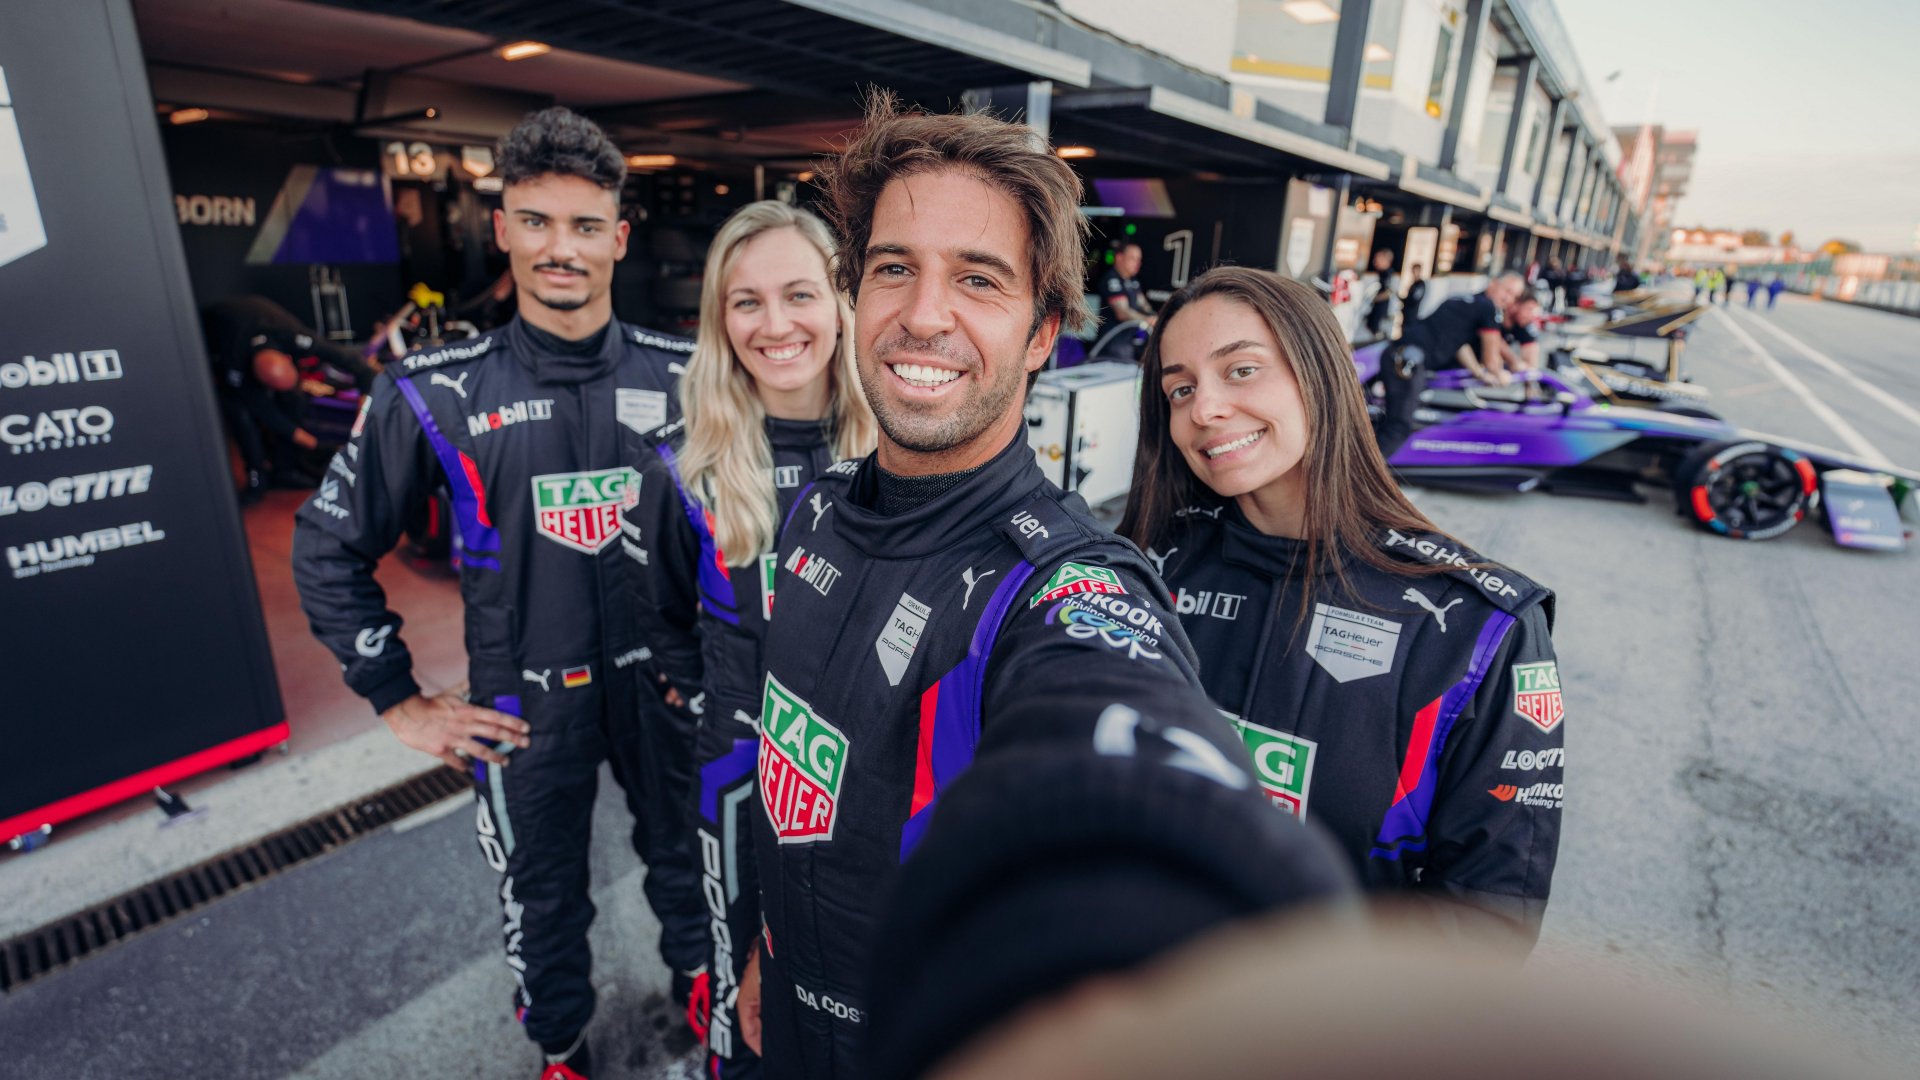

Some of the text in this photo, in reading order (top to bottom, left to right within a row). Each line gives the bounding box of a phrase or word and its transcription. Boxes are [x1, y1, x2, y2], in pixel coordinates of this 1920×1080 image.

[386, 141, 437, 176] 13
[0, 355, 79, 388] obil
[0, 406, 114, 444] CATO
[467, 401, 529, 437] Mobil
[0, 465, 153, 516] LOCTITE
[541, 474, 626, 506] TAG
[7, 521, 165, 568] HUMBEL
[1331, 608, 1360, 621] FORMULA
[1367, 617, 1384, 627] TEAM
[881, 637, 911, 660] PORS
[1324, 625, 1384, 647] TAGHeuer
[1315, 644, 1383, 667] PORSCHE
[767, 687, 839, 784] TAG
[761, 743, 831, 832] HEUER
[795, 983, 861, 1023] DA COS
